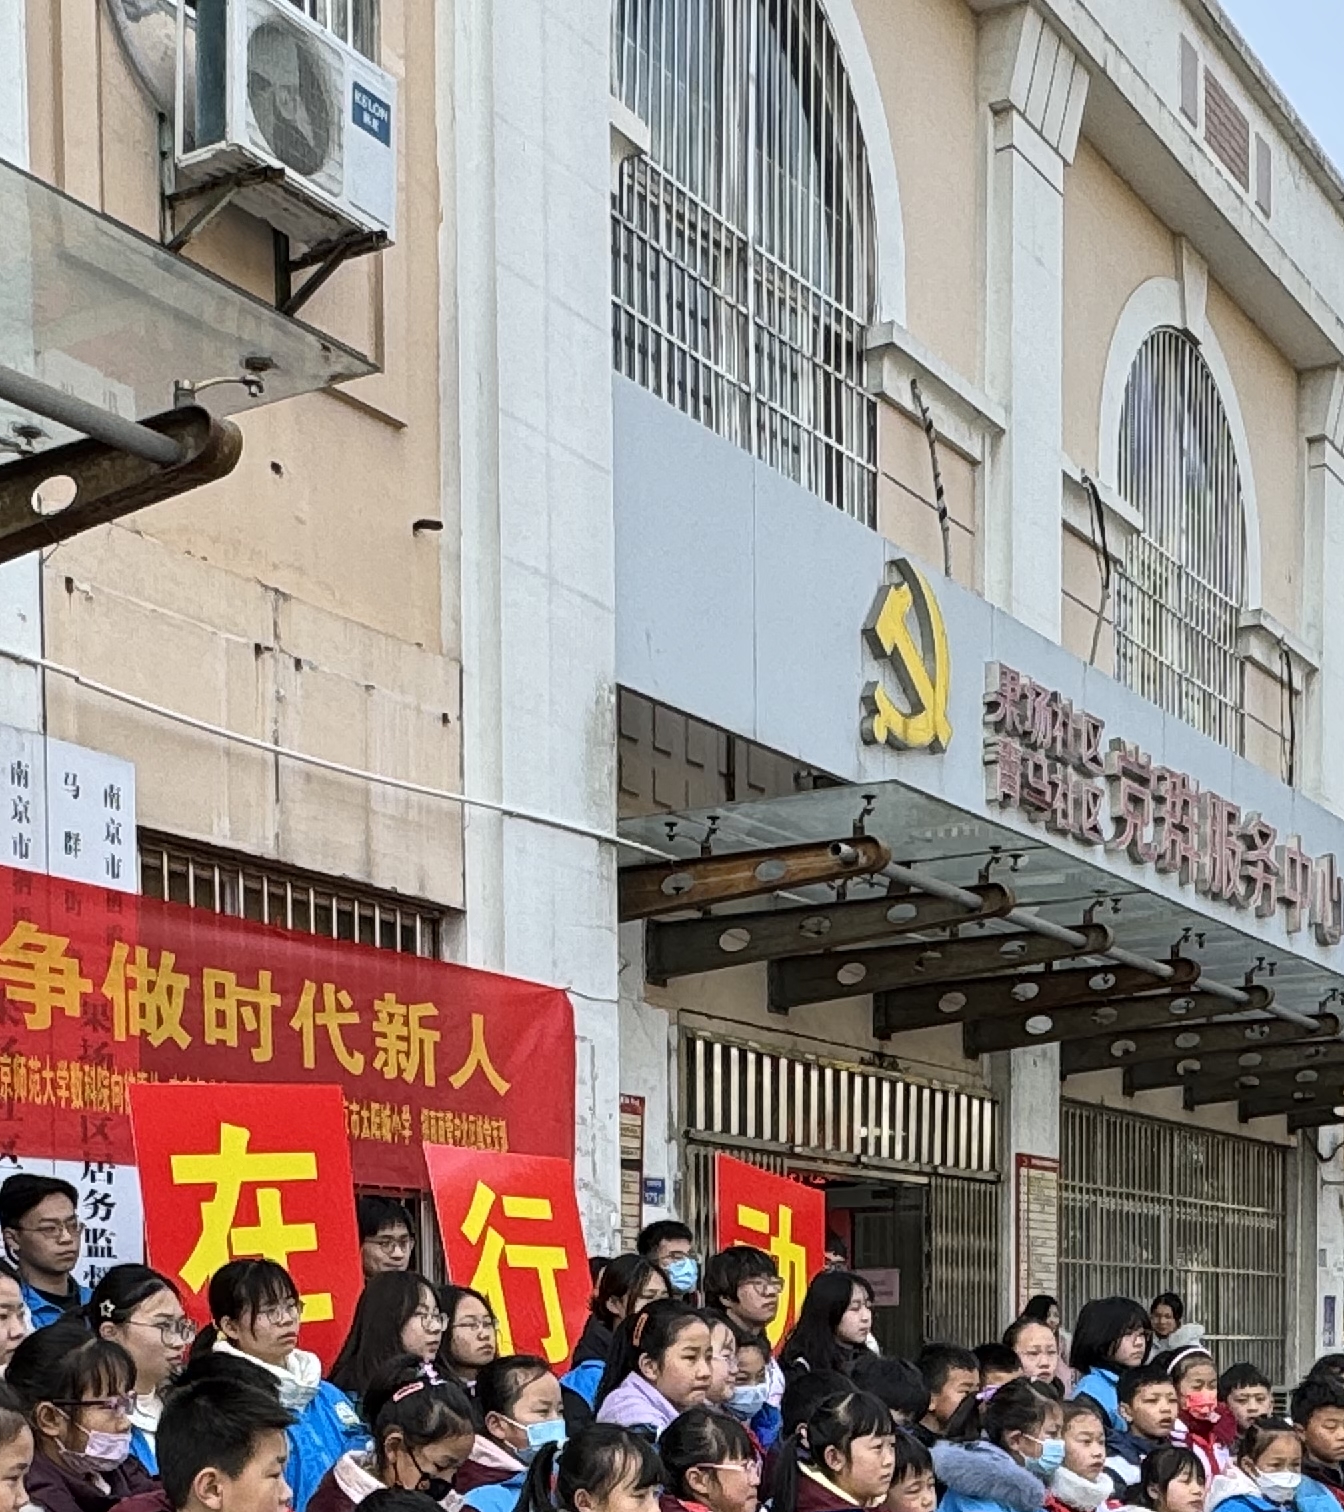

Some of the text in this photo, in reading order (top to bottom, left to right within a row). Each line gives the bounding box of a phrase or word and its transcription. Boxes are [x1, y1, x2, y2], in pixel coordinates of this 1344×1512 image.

[985, 661, 1105, 776] 果场社区
[171, 1121, 335, 1322] 在
[461, 1179, 570, 1364] 行
[734, 1203, 807, 1348] 动
